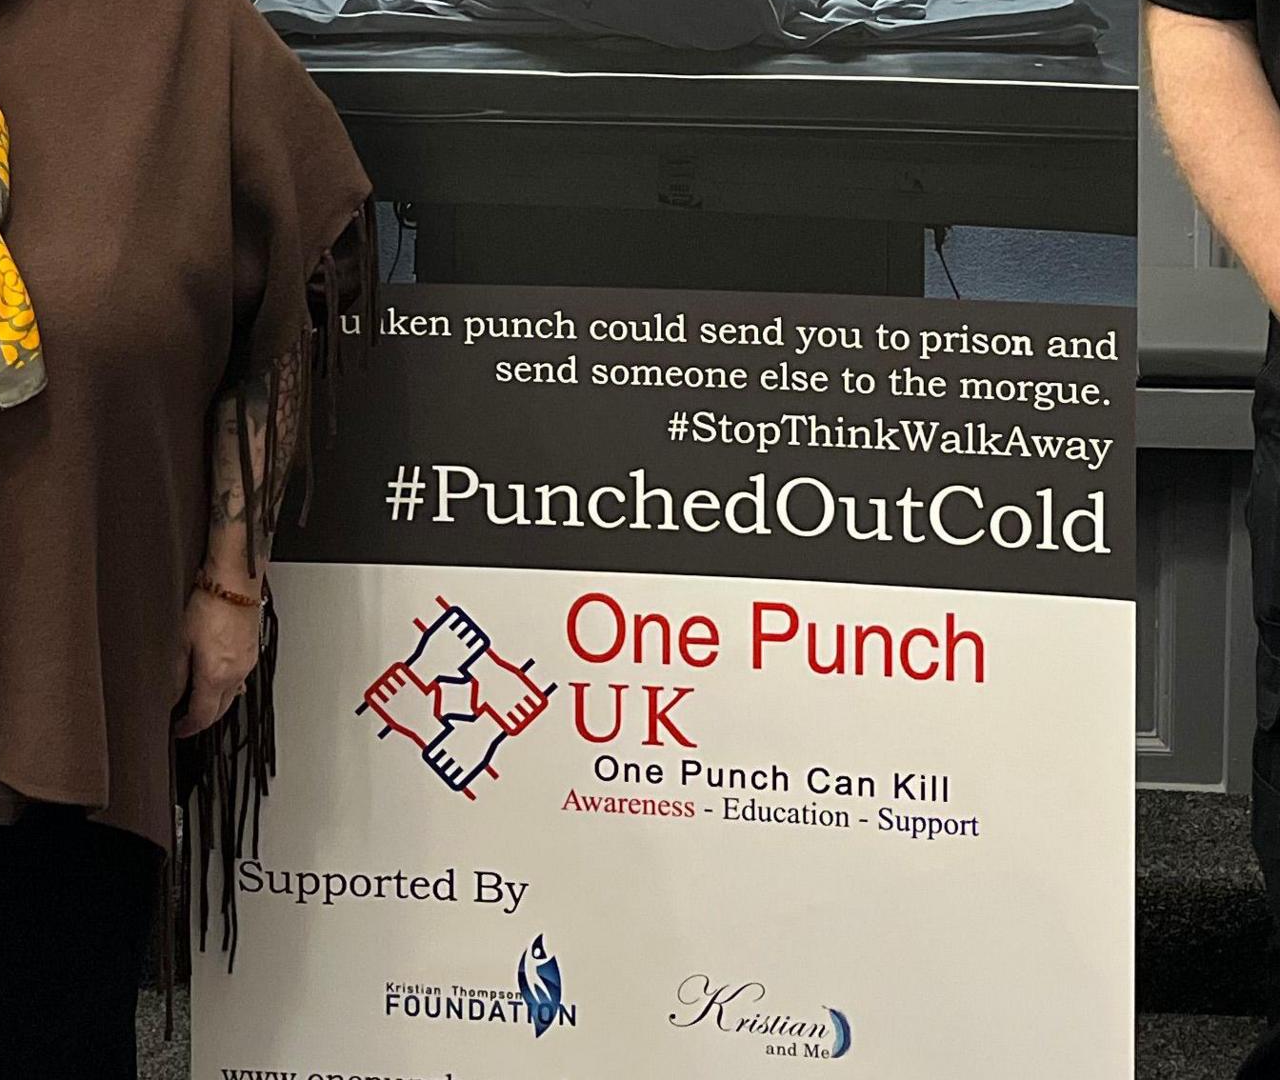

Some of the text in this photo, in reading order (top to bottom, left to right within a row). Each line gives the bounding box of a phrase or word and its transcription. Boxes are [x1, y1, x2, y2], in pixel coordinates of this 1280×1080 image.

[312, 306, 1119, 361] uken punch could send you to prison and
[495, 354, 1111, 411] send someone else to the morgue.
[667, 411, 1114, 470] #StopThinkWalkAway
[385, 464, 1112, 554] #PunchedOutCold
[566, 592, 987, 684] One Punch
[570, 682, 698, 748] UK
[594, 754, 950, 803] One Punch Can Kill
[561, 788, 695, 819] Awareness
[722, 797, 850, 828] Education
[878, 807, 980, 840] Support
[238, 859, 530, 915] Supported By
[385, 982, 523, 1001] Kristian Thompson
[385, 993, 577, 1027] FOUNDATION
[668, 973, 831, 1040] Kristian
[765, 1042, 830, 1060] and Me
